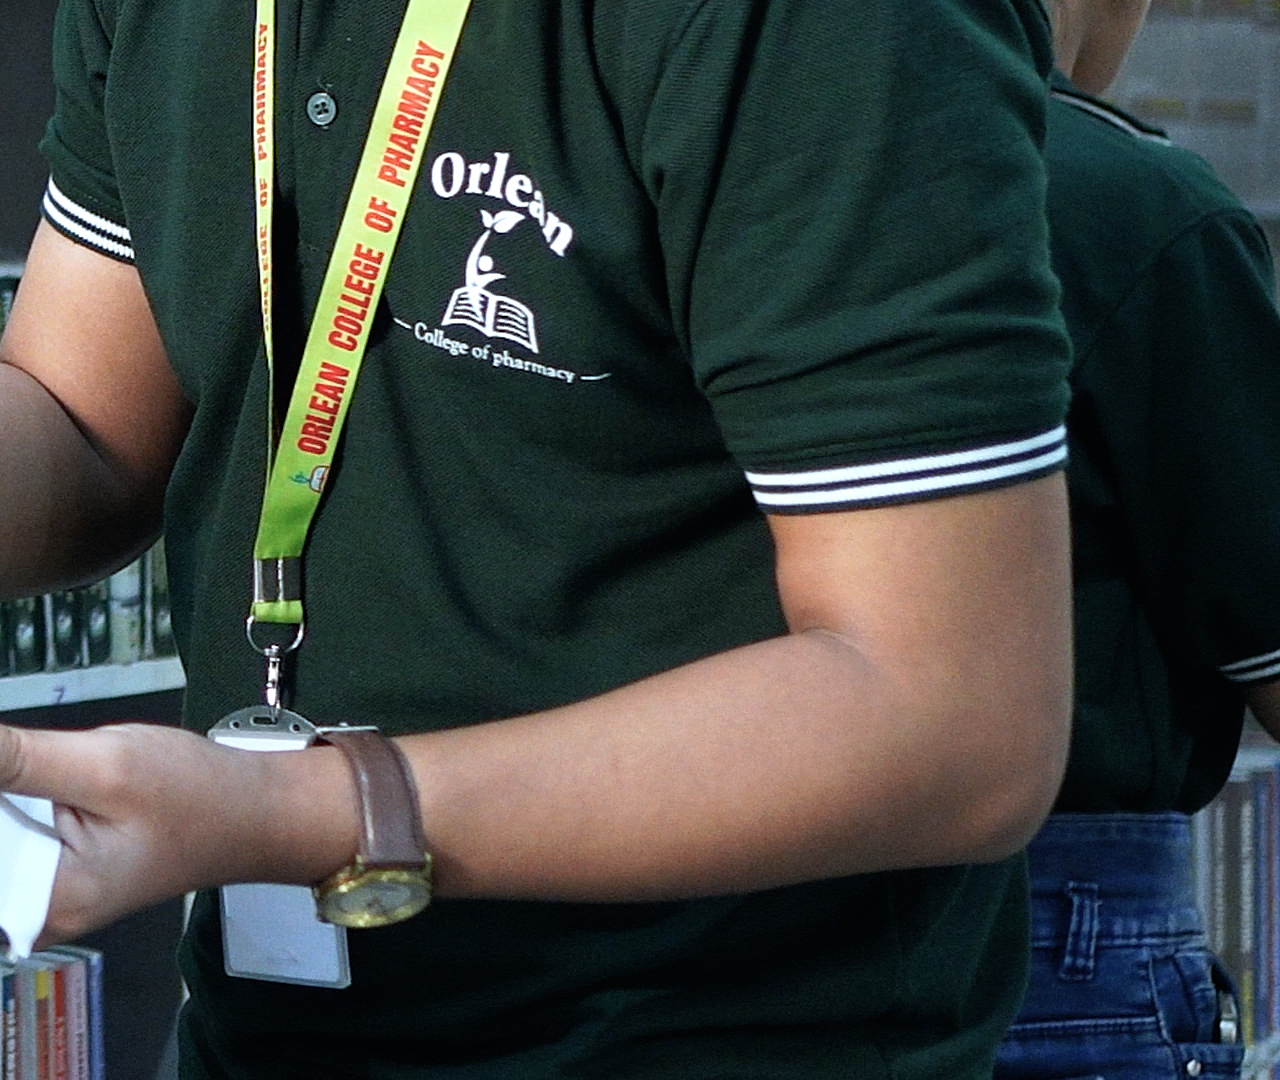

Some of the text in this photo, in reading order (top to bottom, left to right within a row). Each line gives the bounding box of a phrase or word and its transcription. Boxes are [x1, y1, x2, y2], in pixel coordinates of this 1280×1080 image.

[296, 39, 446, 456] ORLEAN COLLEGE OF PHARMACY
[431, 151, 574, 258] Orlean
[413, 321, 576, 383] College of pharmacy
